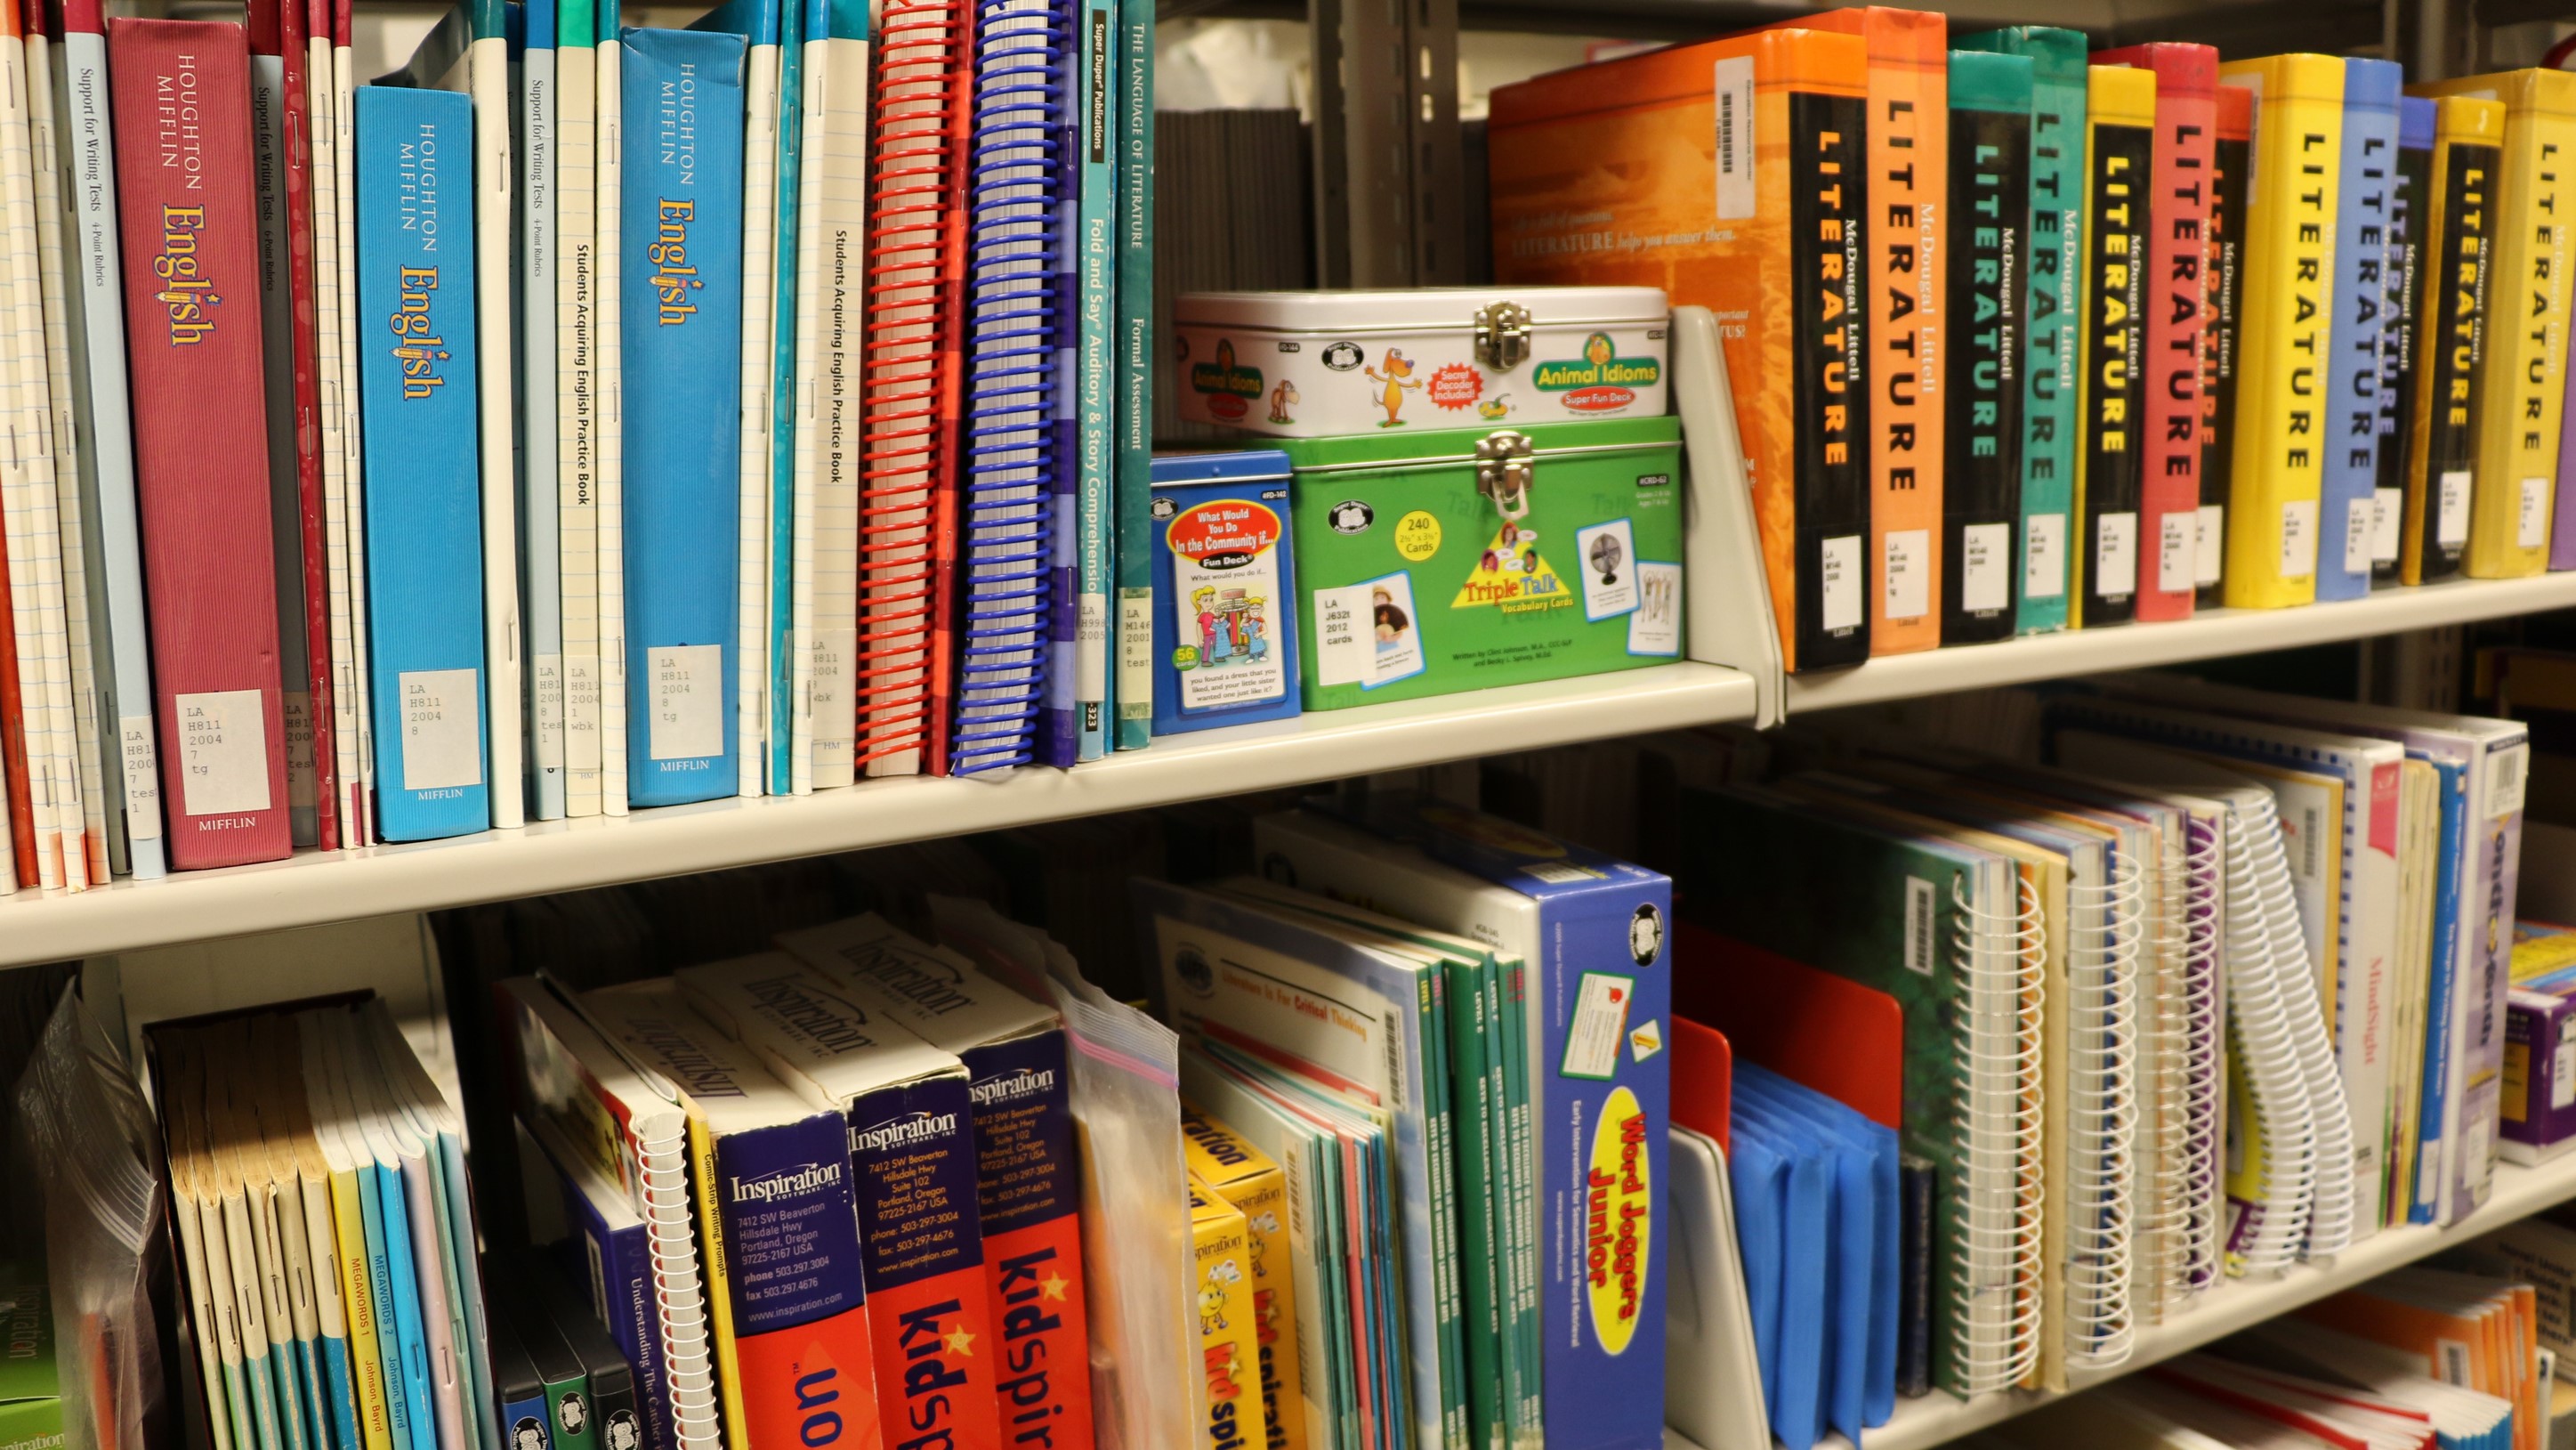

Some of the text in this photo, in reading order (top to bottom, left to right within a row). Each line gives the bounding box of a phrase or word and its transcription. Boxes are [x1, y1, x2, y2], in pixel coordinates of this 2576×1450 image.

[1093, 23, 1104, 52] Super
[157, 75, 178, 167] MIFFLIN
[178, 54, 202, 190] HOUGHTON
[661, 81, 675, 165] MIFFLIN
[680, 63, 695, 185] HOUGHTON
[1094, 90, 1104, 150] Publications
[1131, 23, 1144, 249] THE LANGUAGE OF LITERATURE
[78, 68, 104, 288] Support for Writing Tests 4-Point Rubrics
[400, 143, 416, 231] MIFFLIN
[420, 124, 437, 252] HOUGHTON
[531, 80, 545, 278] Support for Writing Tests 4-Point Rubrics
[1089, 218, 1104, 253] Fold
[154, 203, 218, 348] English
[648, 197, 699, 327] English
[1090, 258, 1103, 288] and
[1819, 130, 1848, 466] LITERATURE
[1845, 219, 1860, 381] McDougal Littell
[1887, 100, 1917, 490] LITERATURE
[1920, 203, 1935, 393] McDougal Littell
[1972, 143, 1999, 458] LITERATURE
[2031, 112, 2060, 481] LITERATURE
[2102, 156, 2129, 452] LITERATURE
[2165, 125, 2202, 477] LITERATURE
[2288, 133, 2326, 469] LITERATURE
[2349, 138, 2386, 470] LITERATURE
[2450, 167, 2484, 428] LITERATURE
[2524, 143, 2558, 450] LITERATURE
[390, 264, 449, 401] English
[830, 230, 847, 483] Students Acquiring English Practice Book
[1085, 335, 1102, 407] Auditory
[574, 244, 589, 506] Students Acquiring English Practice Book
[1131, 318, 1145, 450] Formal Assessment
[1436, 380, 1474, 390] Decoder
[1441, 370, 1469, 380] Secret
[1538, 364, 1657, 385] Animal Idioms
[1434, 389, 1475, 400] Included!
[1565, 393, 1631, 404] Super Fun Deck
[1088, 412, 1101, 424] &
[1085, 429, 1101, 473] Story
[1198, 509, 1249, 522] What Would
[1208, 522, 1238, 534] You Do
[1408, 518, 1430, 531] 240
[1085, 477, 1101, 594] Comprehensio
[1175, 539, 1186, 553] In
[1188, 538, 1203, 551] the
[1205, 533, 1256, 550] Community
[1406, 542, 1433, 553] Cards
[1203, 557, 1221, 567] Fun
[1325, 599, 1338, 609] LA
[1464, 573, 1559, 605] Triple Talk
[1501, 597, 1574, 613] Vocabulary Cards
[1326, 611, 1351, 620] J632t
[1326, 623, 1348, 633] 2012
[1177, 647, 1194, 660] 56
[1327, 636, 1353, 645] cards
[660, 658, 676, 668] LA
[660, 671, 690, 681] H811
[409, 684, 425, 695] LA
[409, 698, 441, 708] H811
[661, 684, 690, 694] 2004
[187, 707, 205, 717] LA
[188, 720, 222, 731] H811
[410, 711, 442, 722] 2004
[662, 711, 677, 723] tg
[190, 734, 222, 746] 2004
[192, 764, 208, 776] tg
[659, 759, 709, 773] MIFFLIN
[417, 789, 464, 801] MIFFLIN
[199, 816, 256, 832] MIFFLIN
[1295, 995, 1368, 1043] Critical Thinking
[968, 1069, 1054, 1106] nspiration
[848, 1113, 957, 1152] Inspiration
[730, 1162, 841, 1203] Inspiration
[828, 1179, 841, 1187] INC
[704, 1154, 726, 1277] Comic-Strip Writing Prompts
[738, 1203, 826, 1228] 7412 SW Beaverton
[739, 1221, 802, 1241] Hillsdale Hwy
[1571, 1100, 1581, 1348] Early Intervention for Semantics and Word Retrieval
[1588, 1167, 1616, 1288] Junior
[1613, 1113, 1646, 1321] Word Joggers
[740, 1230, 819, 1253] Portland, Oregon
[741, 1242, 814, 1266] 97225-2167 USA
[744, 1255, 829, 1285] phone 503.297.3004
[746, 1277, 819, 1301] fax 503.297.4676
[748, 1292, 843, 1323] www.inspiration.com
[351, 1258, 384, 1432] MEGAWORDS Johnson, Bayrd
[375, 1255, 406, 1429] MEGAWORDS Johnson, Bayrd
[631, 1277, 651, 1368] Understanding
[643, 1369, 656, 1393] The
